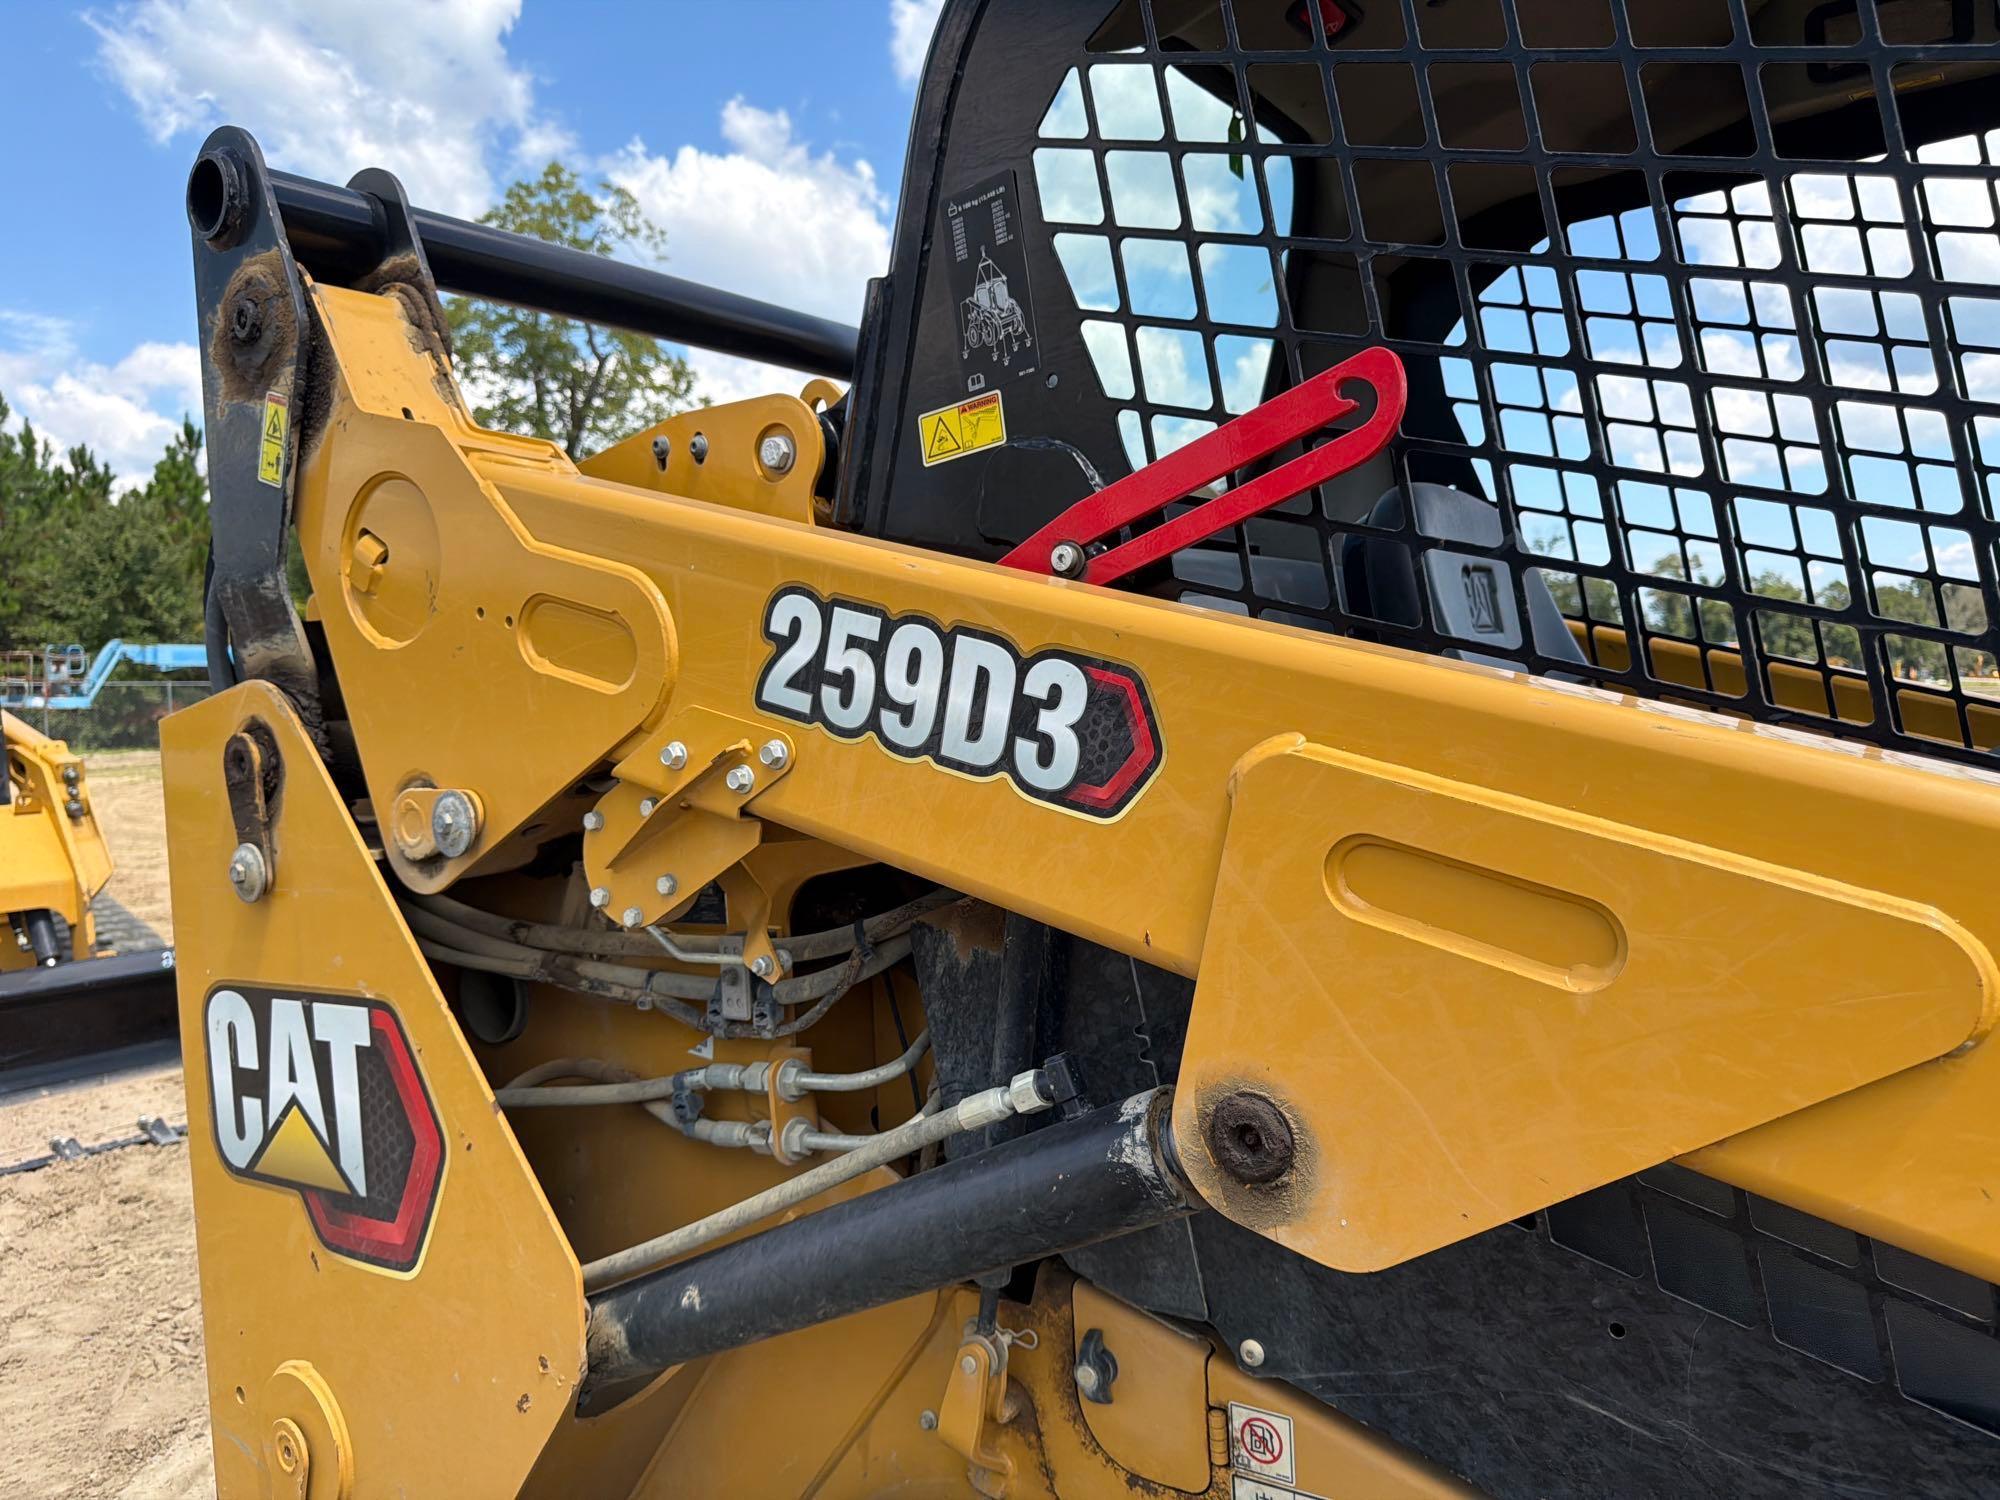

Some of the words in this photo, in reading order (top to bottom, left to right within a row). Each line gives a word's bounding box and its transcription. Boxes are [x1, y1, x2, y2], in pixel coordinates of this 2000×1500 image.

[967, 395, 997, 410] WARNING
[1461, 564, 1502, 632] CAT
[761, 593, 1089, 792] 259D3
[207, 989, 371, 1198] CAT
